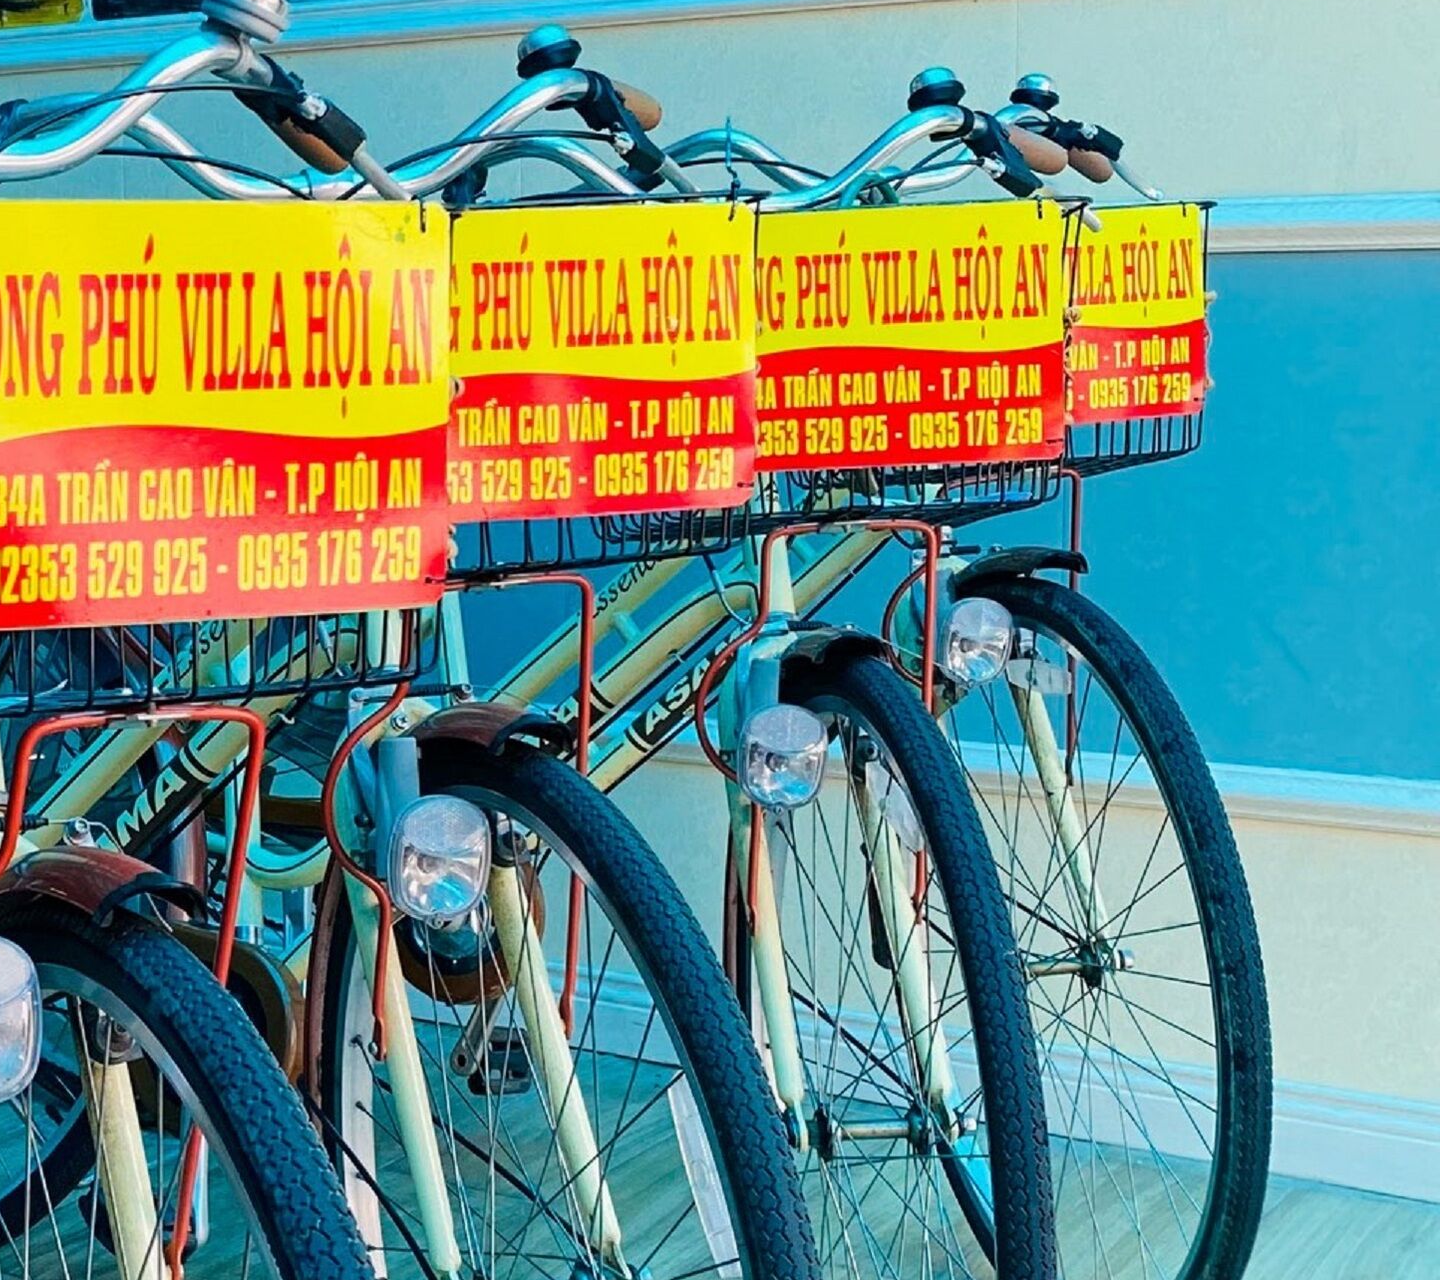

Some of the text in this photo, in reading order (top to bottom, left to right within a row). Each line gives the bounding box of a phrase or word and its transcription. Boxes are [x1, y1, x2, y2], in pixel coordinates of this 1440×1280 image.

[471, 232, 533, 351] PHÚ
[545, 258, 633, 348] VILLA
[641, 228, 695, 367] HỘI
[703, 254, 741, 341] AN
[795, 229, 851, 329] PHÚ
[861, 249, 945, 324] VILLA
[953, 224, 1003, 340] HỘI
[1012, 244, 1048, 317] AN
[1121, 223, 1160, 318] HỘI
[1167, 239, 1194, 299] AN
[79, 233, 160, 394] PHÚ
[176, 272, 291, 392] VILLA
[304, 233, 372, 419] HỘI
[384, 269, 434, 386] AN
[1171, 336, 1190, 364] AN
[838, 372, 876, 406] CAO
[883, 365, 920, 404] VÂN
[941, 367, 970, 400] T.P
[976, 361, 1009, 406] HỘI
[1015, 364, 1041, 397] AN
[1090, 377, 1128, 409] 0935
[1132, 374, 1158, 406] 176
[1163, 372, 1191, 403] 259
[519, 404, 559, 445] CAO
[566, 397, 607, 442] VÂN
[630, 400, 660, 439] T.P
[666, 391, 701, 445] HỘI
[707, 395, 734, 435] AN
[806, 417, 843, 454] 529
[850, 415, 888, 452] 925
[909, 412, 959, 450] 0935
[965, 409, 998, 447] 176
[1005, 407, 1042, 444] 259
[139, 468, 193, 521] CAO
[202, 457, 255, 518] VÂN
[265, 489, 277, 499] -
[285, 463, 325, 514] T.P
[334, 451, 378, 522] HỘI
[387, 458, 421, 509] AN
[481, 458, 522, 503] 529
[530, 456, 571, 501] 925
[594, 451, 648, 497] 0935
[654, 450, 688, 494] 176
[695, 447, 734, 491] 259
[88, 540, 143, 600] 529
[154, 537, 207, 596] 925
[217, 564, 228, 574] -
[238, 531, 308, 591] 0935
[318, 529, 362, 587] 176
[371, 526, 421, 583] 259
